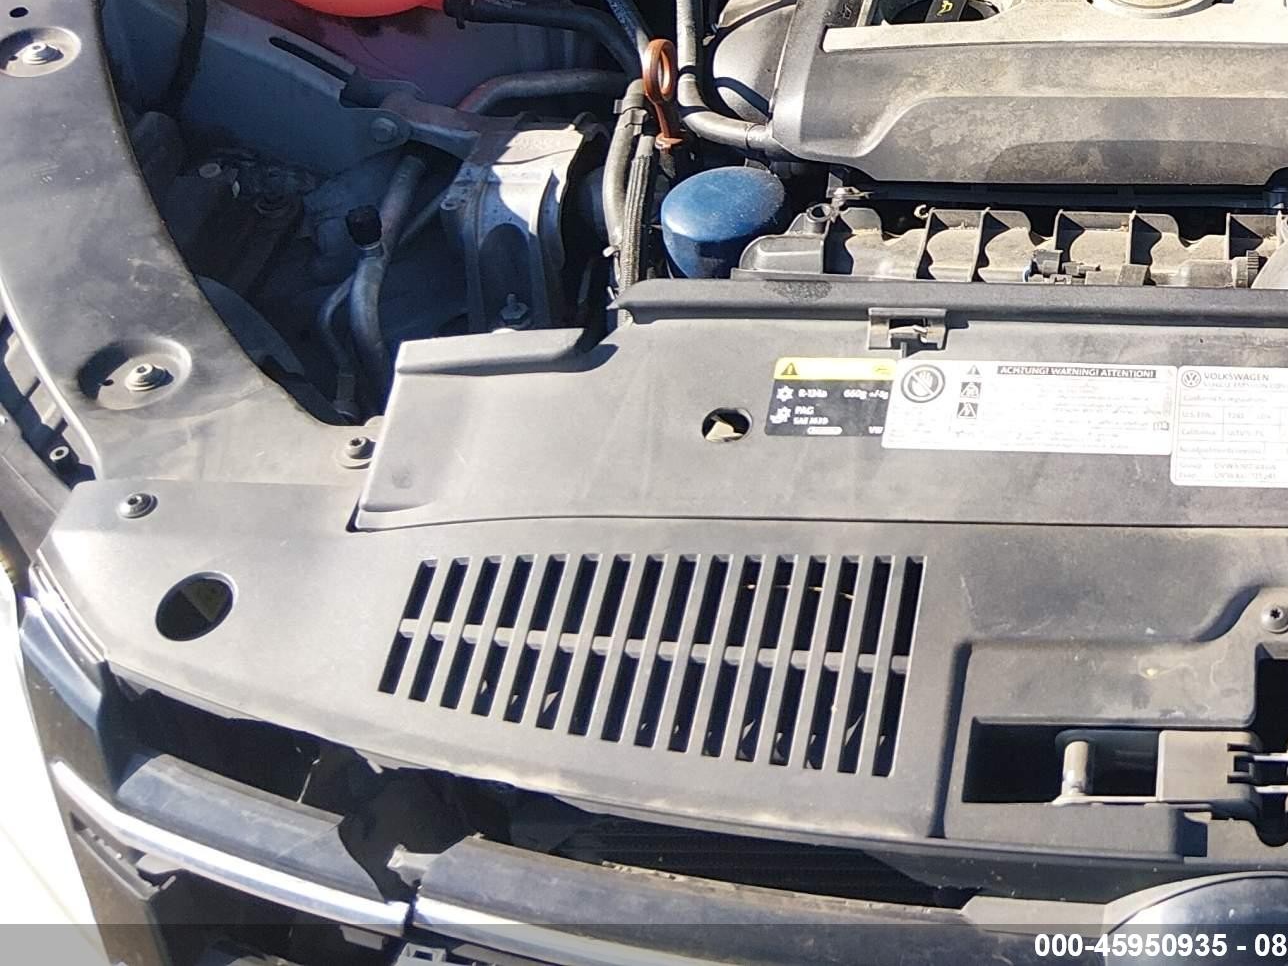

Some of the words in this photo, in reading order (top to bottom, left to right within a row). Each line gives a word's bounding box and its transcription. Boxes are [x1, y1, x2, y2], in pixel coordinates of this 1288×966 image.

[1000, 366, 1049, 375] ACHTUNG!
[1051, 367, 1099, 377] WARNING!
[1101, 369, 1154, 378] ATTENTION!
[1204, 372, 1270, 381] VOLKSWAGEN
[794, 405, 815, 415] PAG
